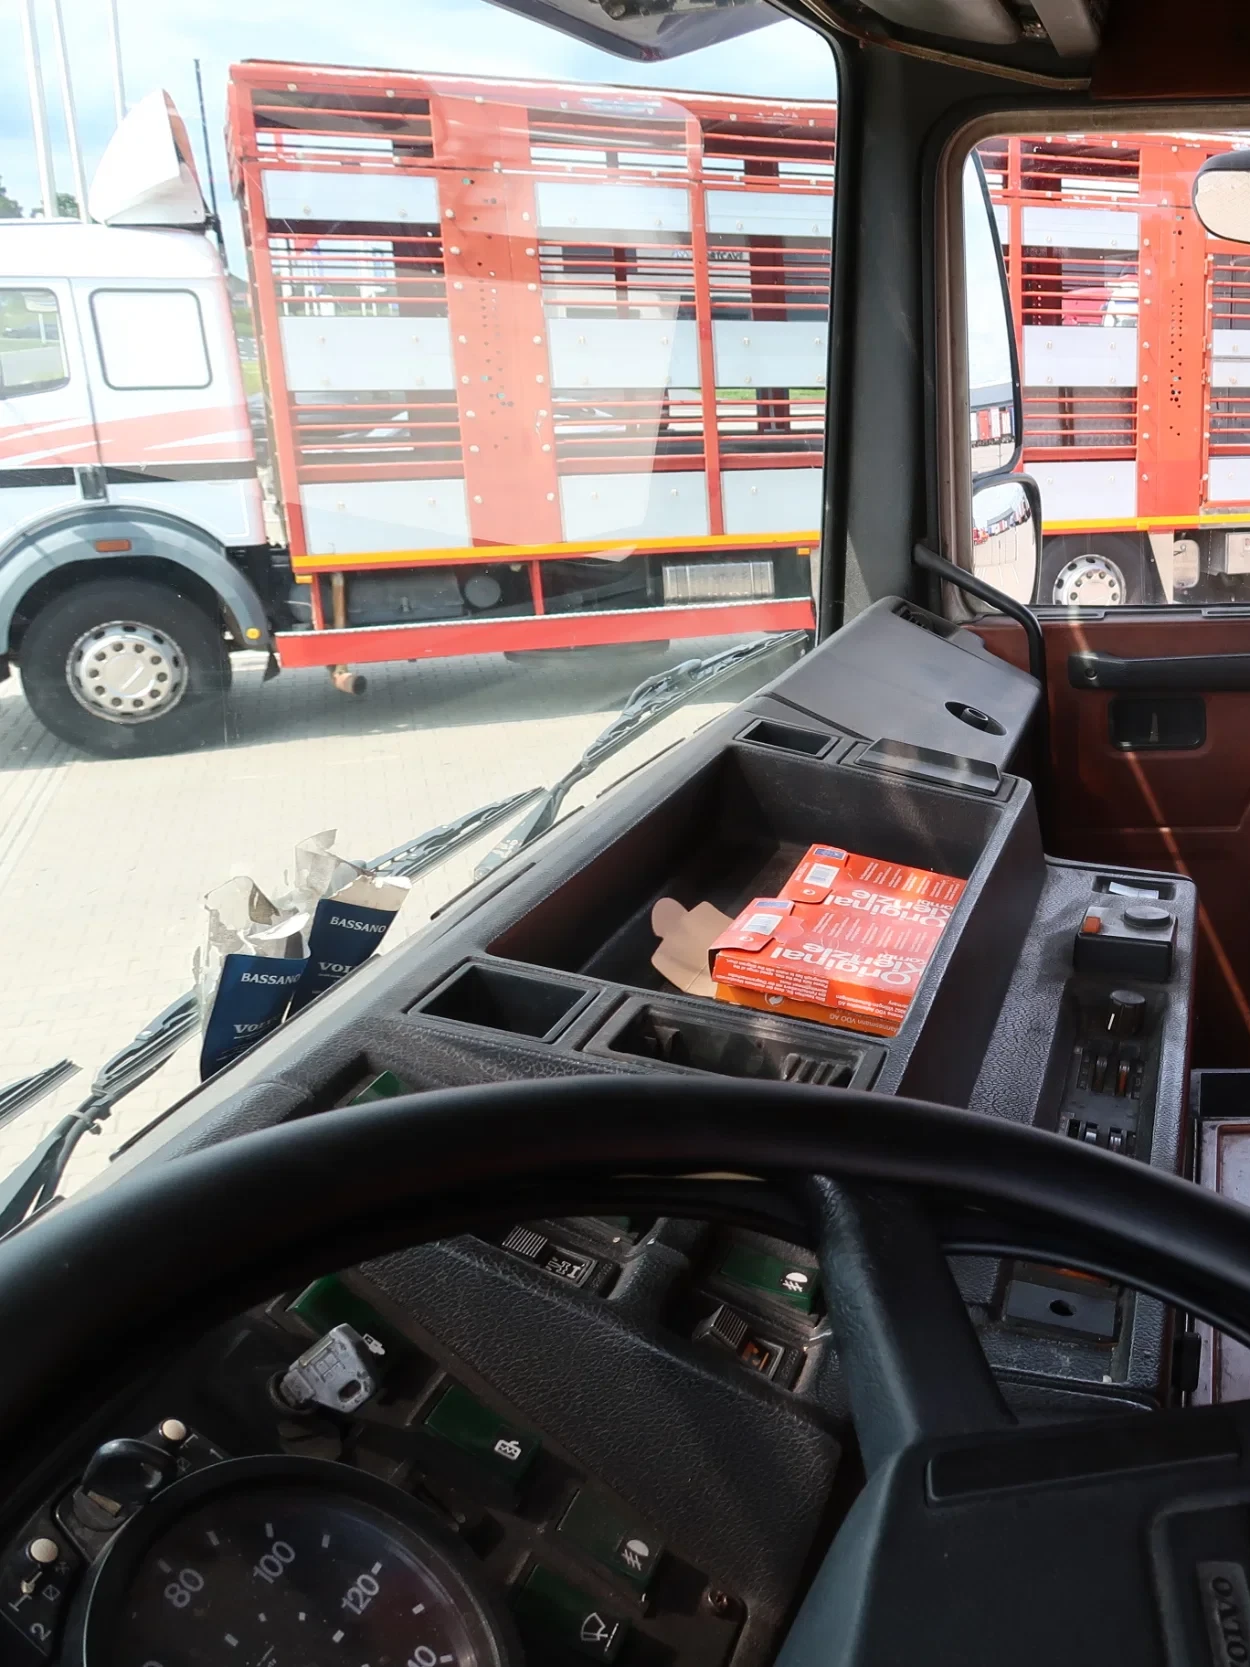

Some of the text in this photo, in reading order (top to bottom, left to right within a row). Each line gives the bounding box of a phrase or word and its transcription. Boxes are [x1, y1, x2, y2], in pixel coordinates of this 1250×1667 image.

[823, 894, 946, 928] Original
[917, 899, 954, 910] ombi
[329, 916, 387, 934] BASSANO
[240, 972, 301, 985] BASSANO
[770, 946, 912, 985] Original
[253, 1540, 296, 1584] 100
[164, 1567, 205, 1608] 80
[341, 1573, 379, 1615] 120
[29, 1622, 52, 1642] 2
[1212, 1576, 1249, 1667] OLVO
